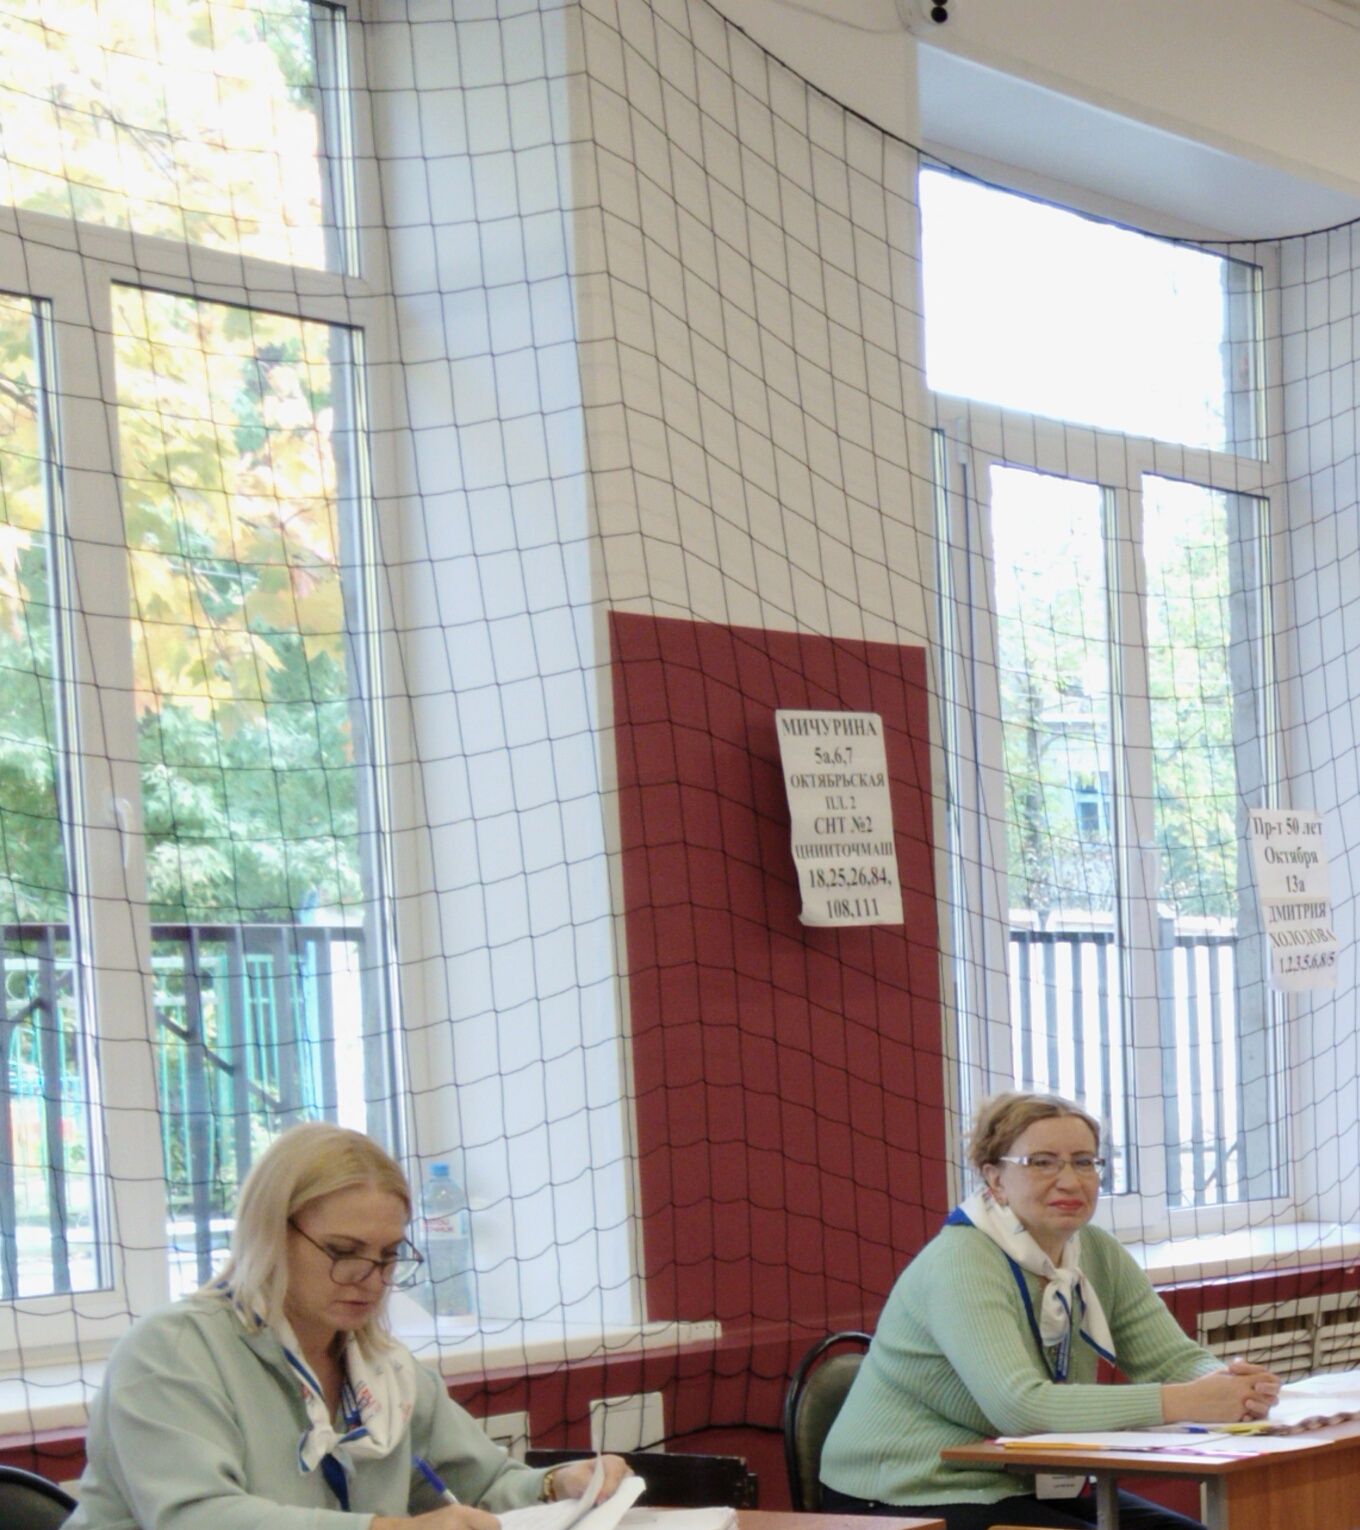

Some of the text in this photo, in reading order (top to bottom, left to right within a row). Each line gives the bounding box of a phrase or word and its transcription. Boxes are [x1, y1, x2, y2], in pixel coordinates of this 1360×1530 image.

[782, 718, 877, 736] МИЧУРИНА
[814, 747, 853, 765] 5а,6,7
[790, 773, 885, 789] ОКТЯБРЬСКАЯ
[814, 817, 846, 835] СНТ
[1253, 816, 1323, 840] Пр-т 50 лет
[794, 841, 894, 860] ЦНИИТОЧМАШ
[1264, 846, 1319, 868] Октября
[827, 898, 880, 919] 108,111
[1268, 902, 1327, 924] ДМИТРИЯ
[1268, 928, 1337, 949] ХОЛОДОВА
